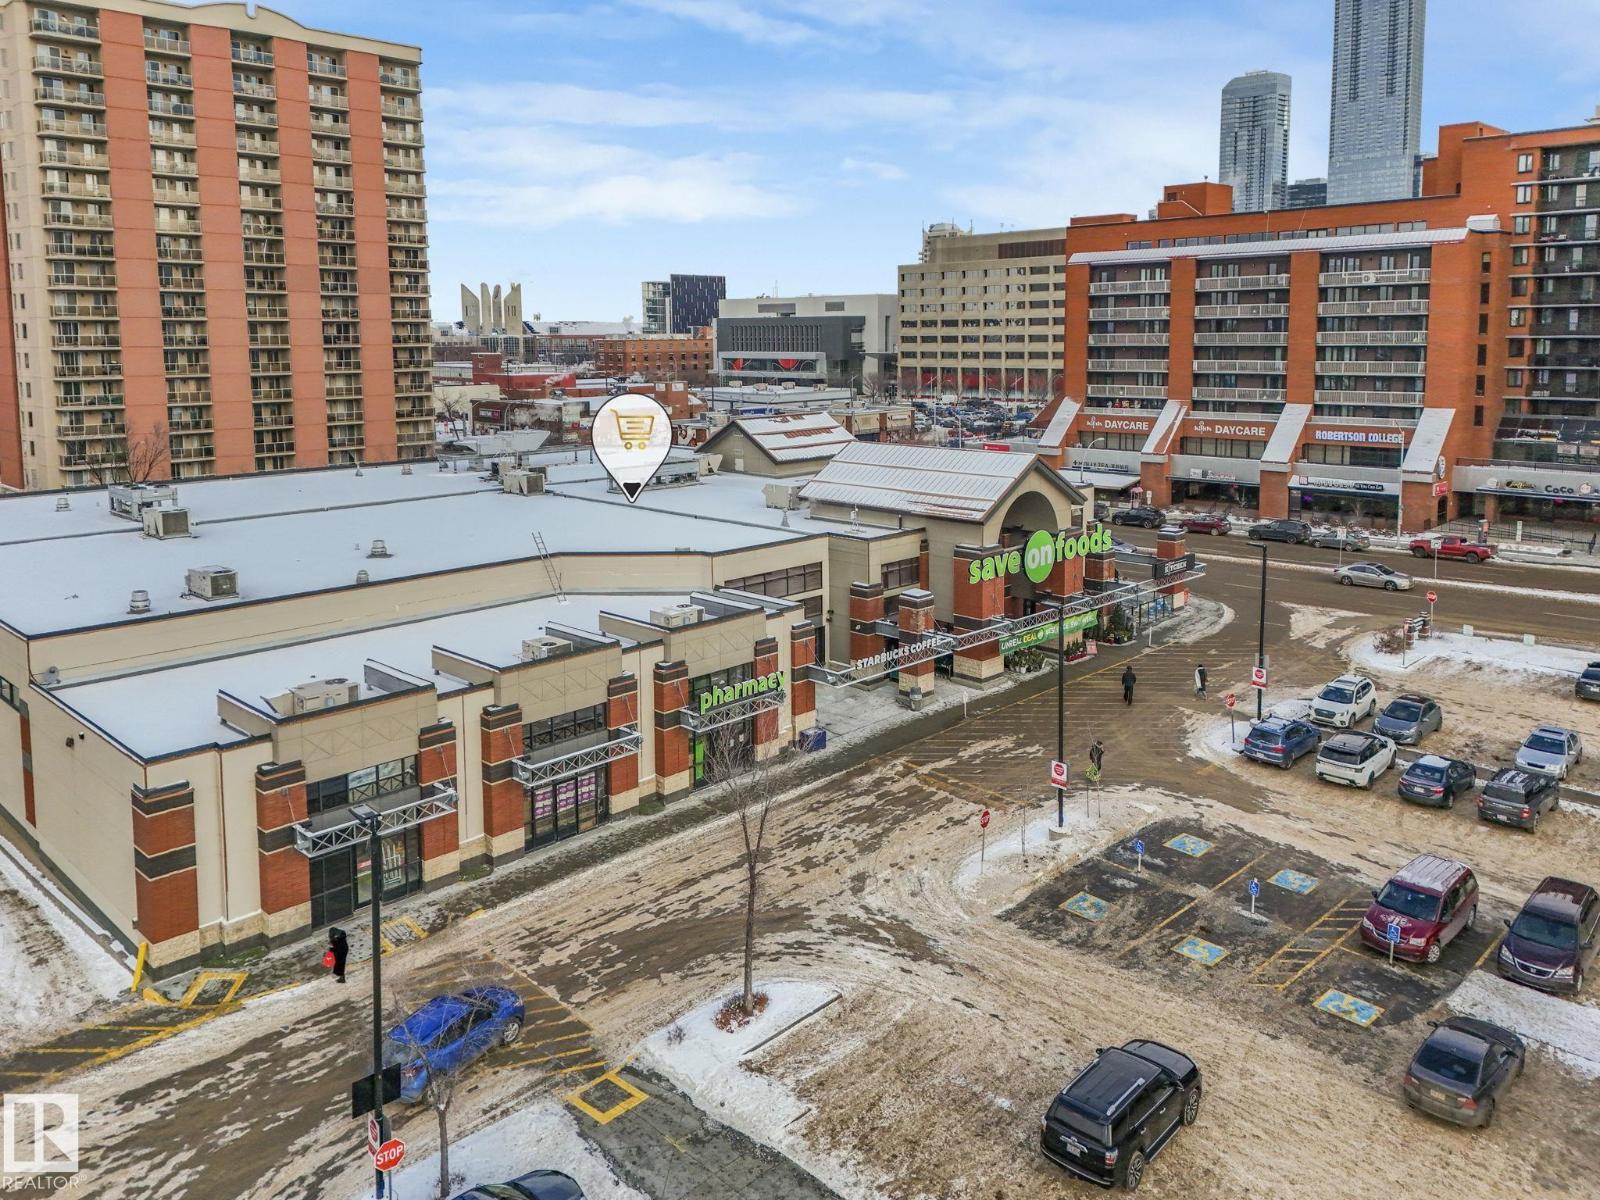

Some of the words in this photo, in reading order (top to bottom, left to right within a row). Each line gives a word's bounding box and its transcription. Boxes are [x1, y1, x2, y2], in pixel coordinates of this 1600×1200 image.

[1104, 420, 1149, 431] DAYCARE
[1215, 425, 1266, 436] DAYCARE
[1315, 430, 1366, 442] ROBERTSON
[1368, 433, 1404, 444] COLLEGE
[969, 551, 1021, 584] save
[1027, 544, 1053, 569] on
[1056, 523, 1113, 562] foods
[856, 645, 910, 670] STARBUCKS
[910, 635, 941, 653] COFFEE
[700, 671, 786, 715] pharmacy
[376, 1145, 404, 1165] STOP
